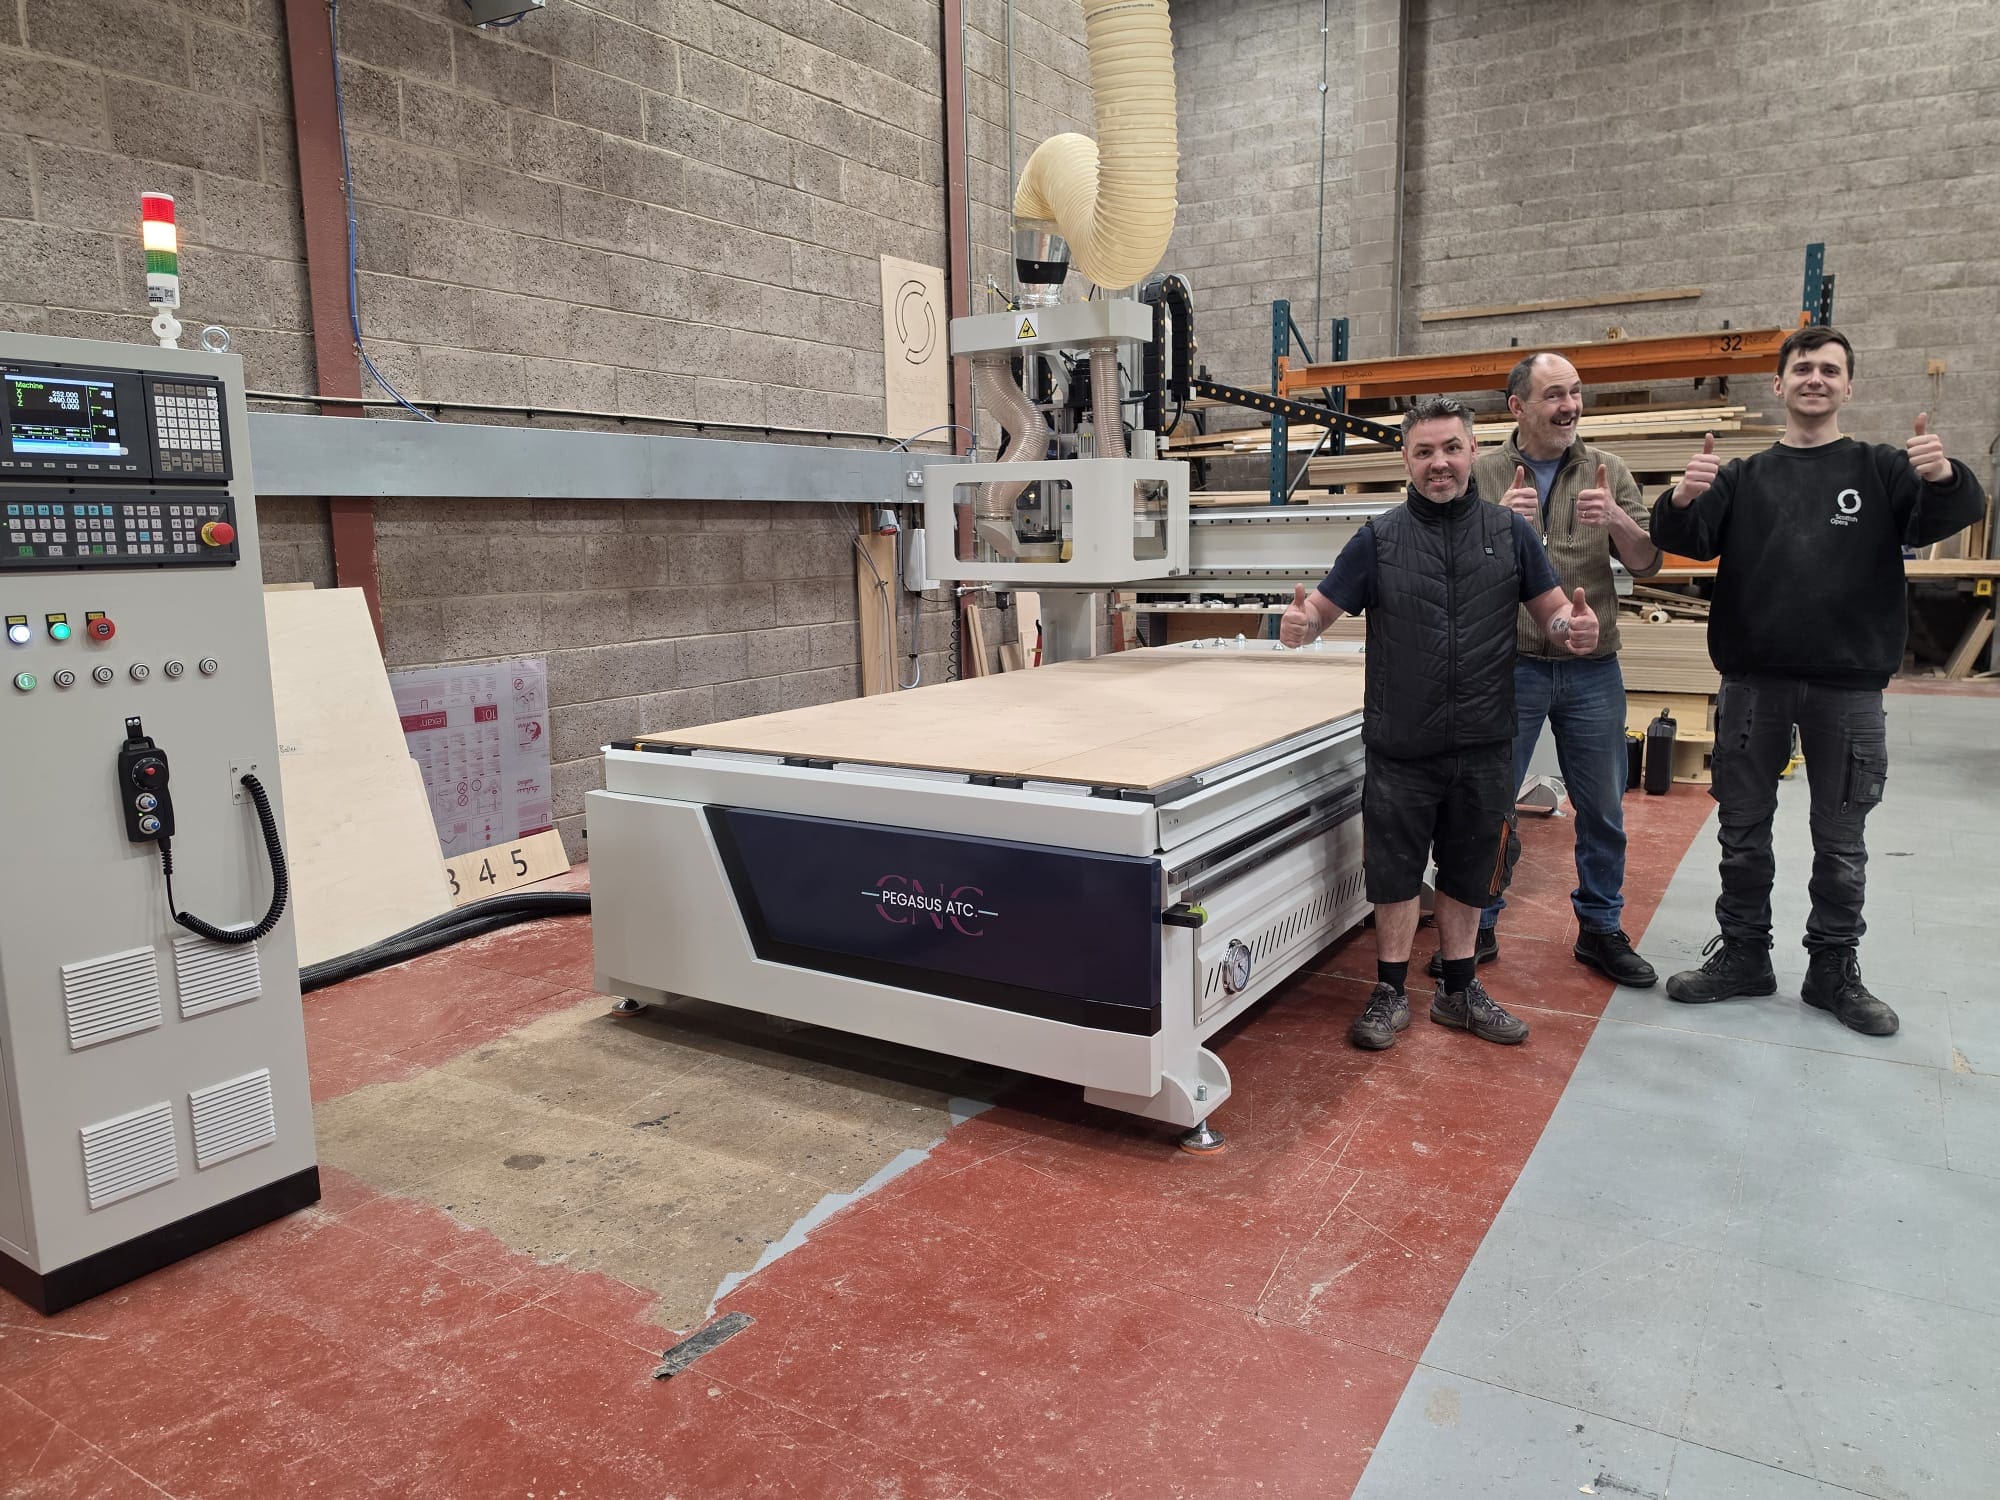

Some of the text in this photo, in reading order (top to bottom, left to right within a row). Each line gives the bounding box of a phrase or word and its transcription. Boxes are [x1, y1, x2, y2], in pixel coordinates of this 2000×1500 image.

[1720, 335, 1742, 352] 32
[16, 381, 43, 389] Machine
[1830, 518, 1848, 526] Opera
[1835, 513, 1858, 523] Scottish
[139, 668, 145, 676] 4
[173, 664, 179, 672] 5
[208, 662, 214, 670] 6
[447, 848, 528, 896] 3 4 5
[882, 890, 942, 912] PEGASUS
